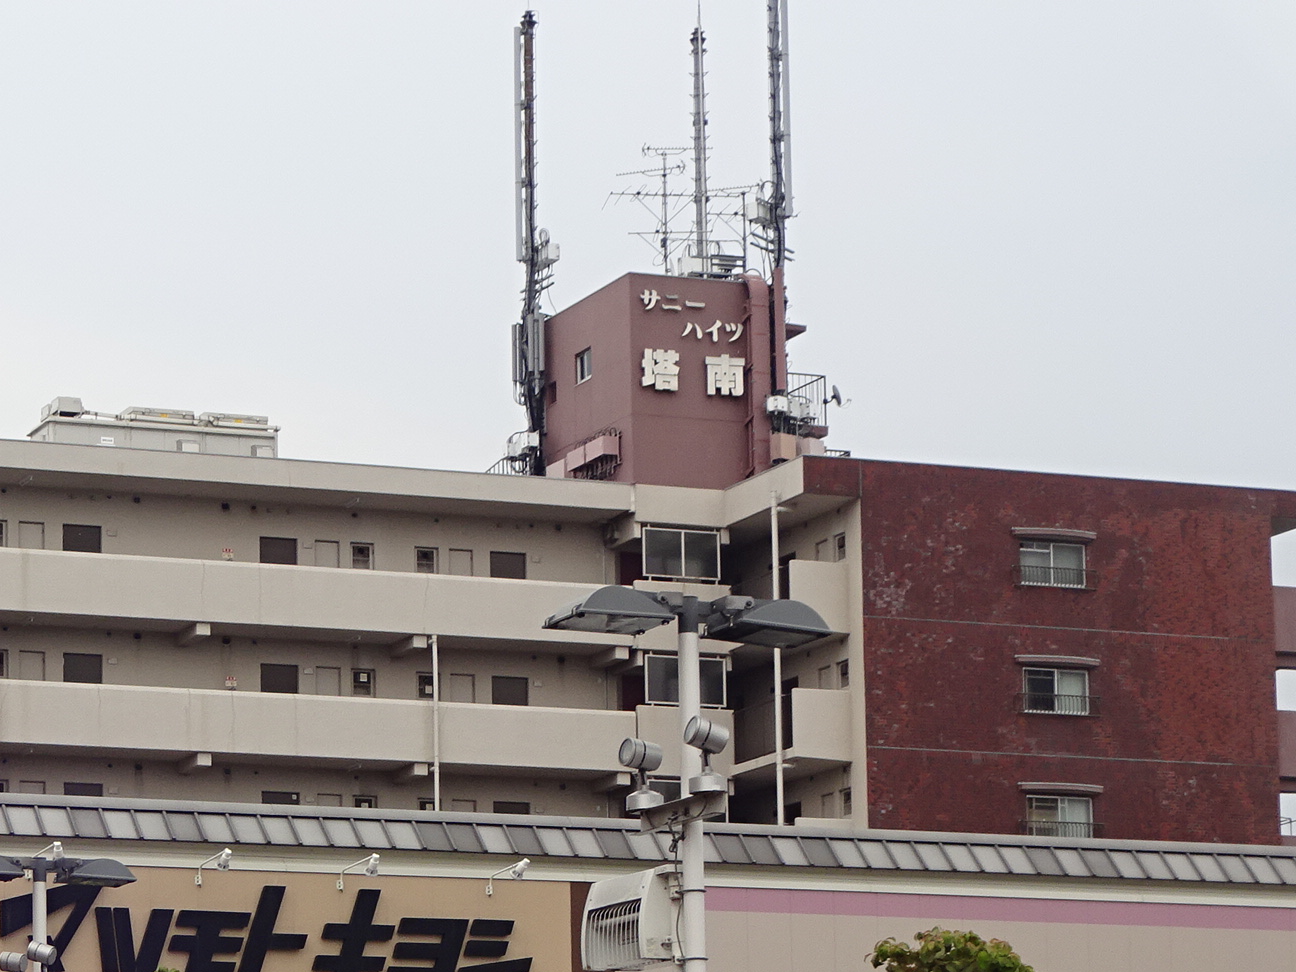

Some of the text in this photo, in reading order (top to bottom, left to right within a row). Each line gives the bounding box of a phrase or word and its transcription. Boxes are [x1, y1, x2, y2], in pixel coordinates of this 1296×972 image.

[639, 288, 706, 311] サニー
[681, 319, 744, 343] ハイツ
[641, 348, 746, 397] 塔南
